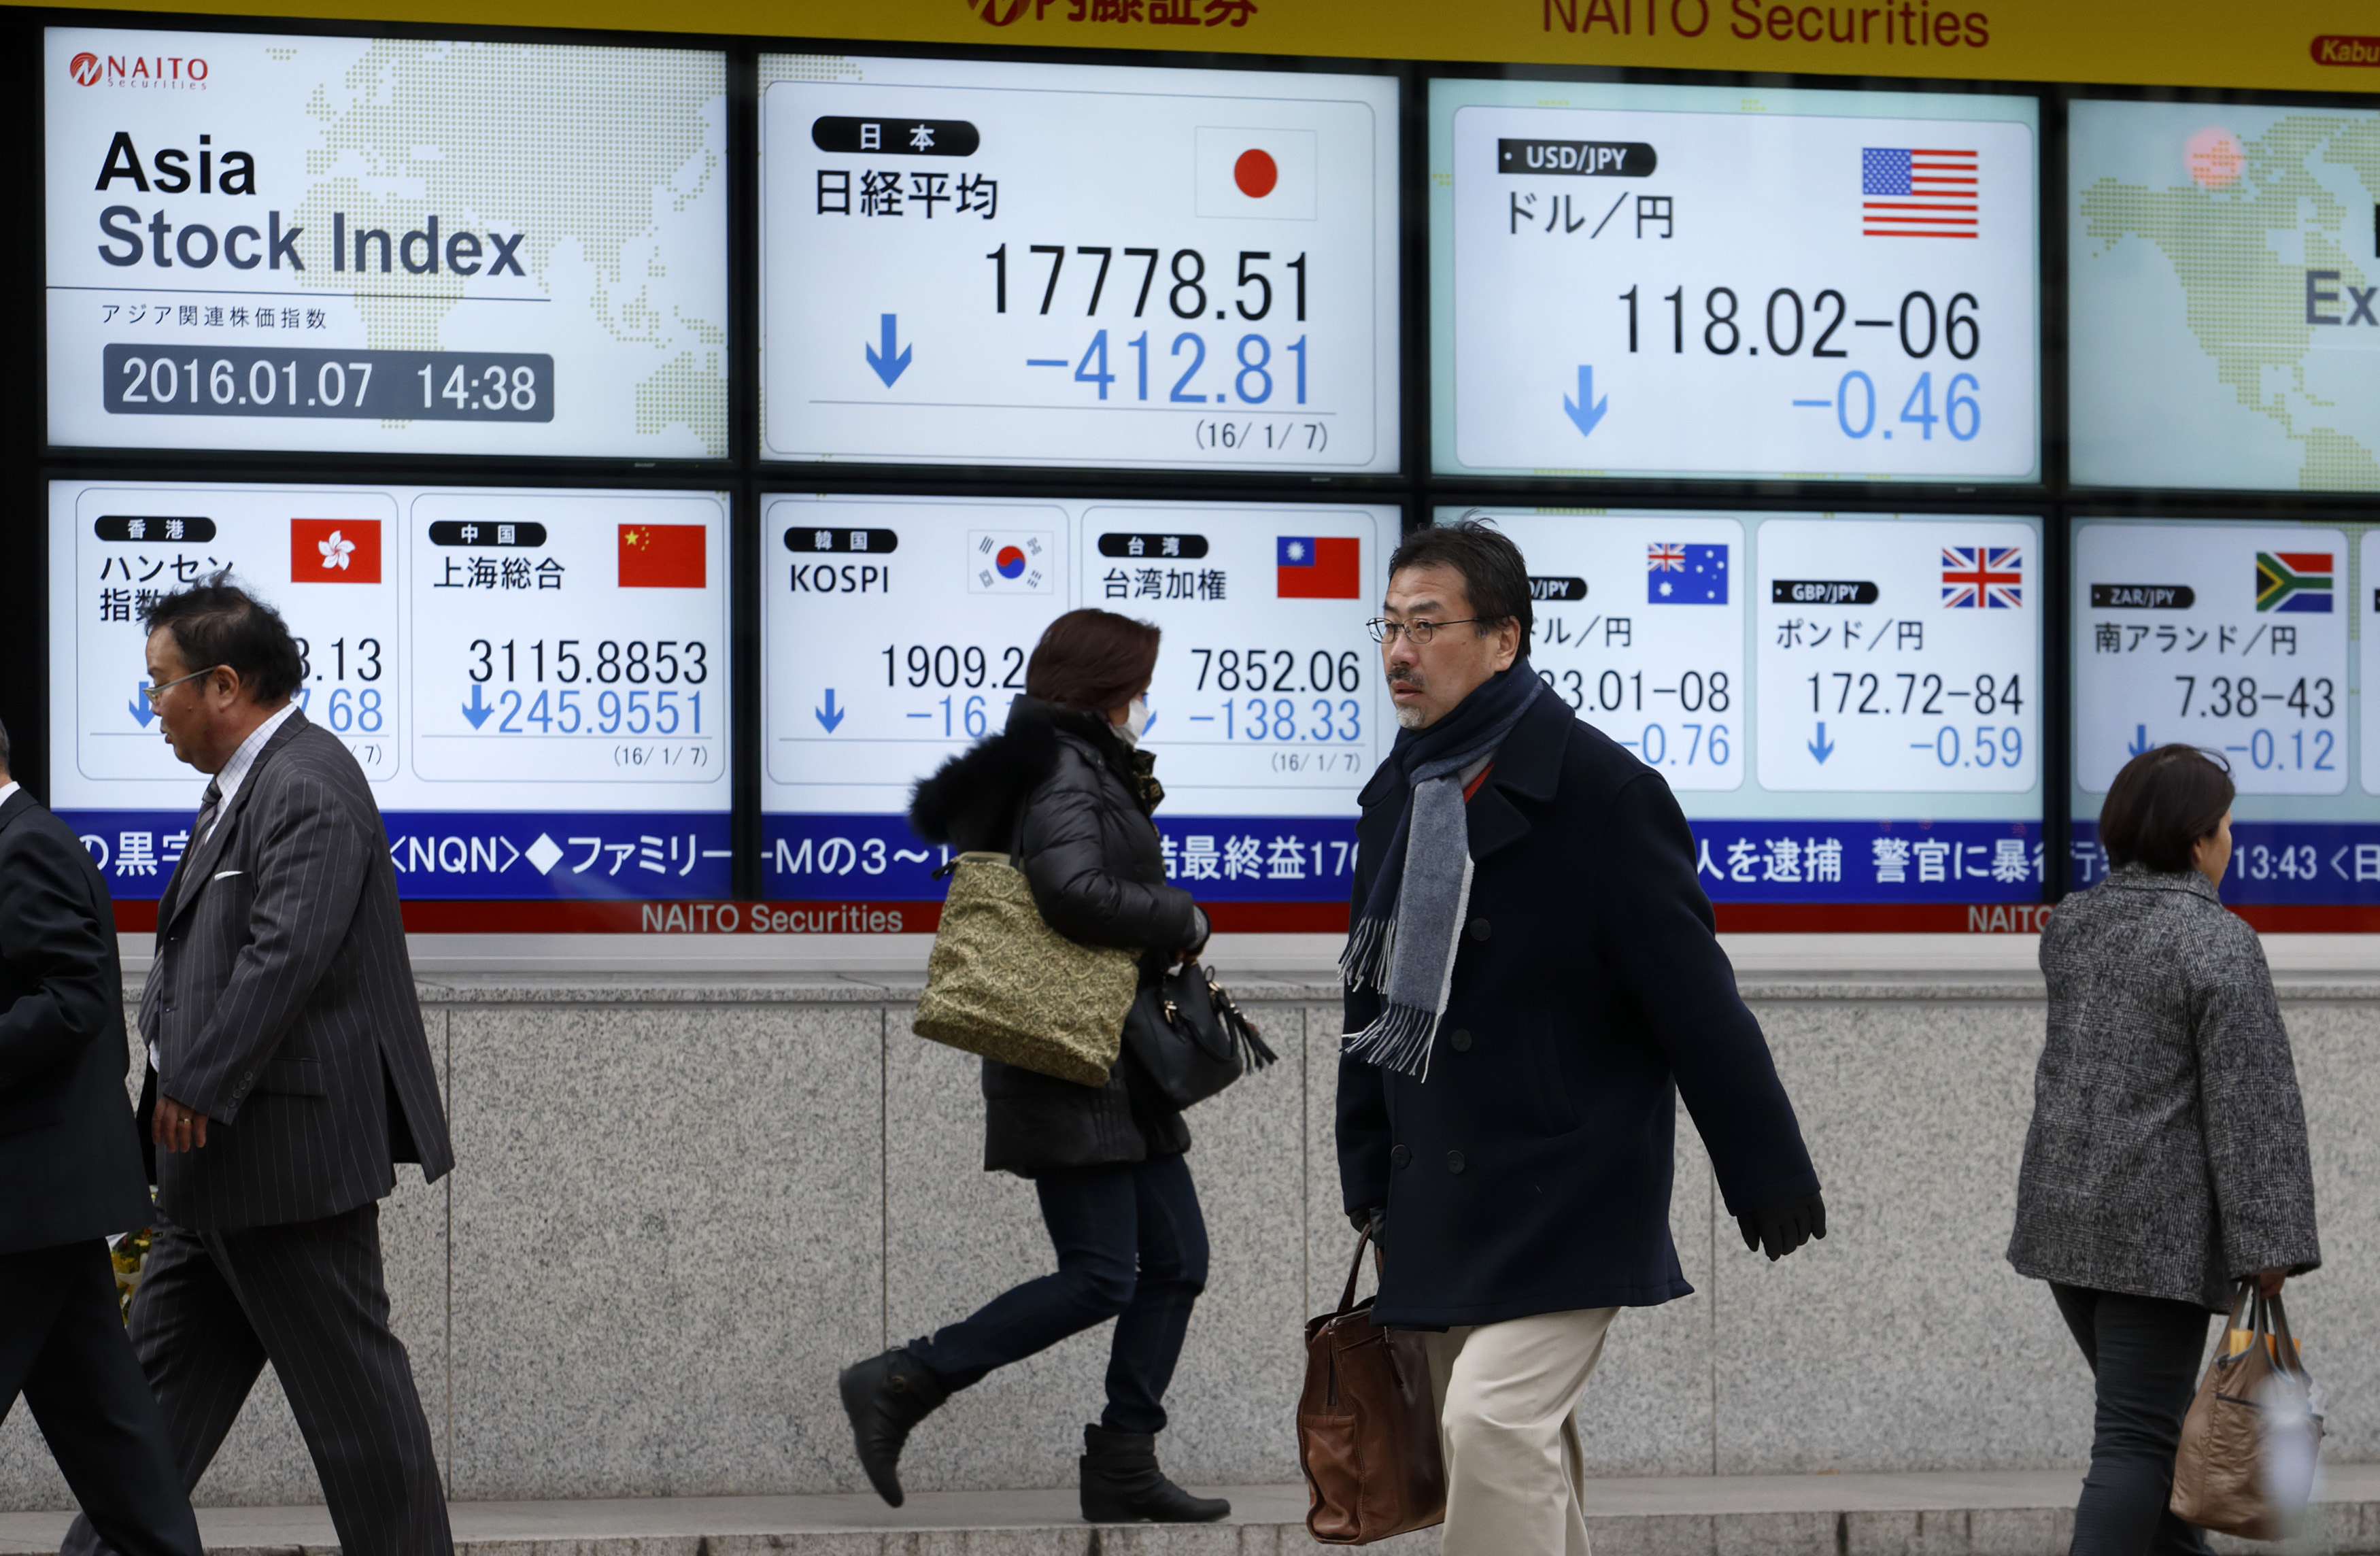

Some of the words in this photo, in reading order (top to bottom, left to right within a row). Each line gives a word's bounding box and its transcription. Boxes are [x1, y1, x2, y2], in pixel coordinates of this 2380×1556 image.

[1543, 0, 1709, 37] NAITO
[1731, 0, 1990, 48] Securities
[107, 56, 208, 81] NAITO
[107, 78, 207, 90] Securities
[95, 132, 256, 195] Asia
[1526, 145, 1627, 175] USD/JPY
[817, 169, 997, 219] 日経平均
[98, 205, 305, 272] Stock
[334, 212, 526, 276] Index
[987, 243, 1306, 321] 17778.51
[103, 305, 325, 328] アジア関連株価指数
[1620, 285, 1979, 360] 118.02-06
[123, 358, 372, 407] 2016.01.07
[418, 365, 536, 410] 14:38
[1027, 330, 1306, 404] -412.81
[1793, 371, 1981, 441] -0.46
[100, 554, 233, 583] ハンセン
[434, 557, 564, 590] 上海総合
[791, 564, 887, 592] KOSPI
[1104, 568, 1225, 600] 台湾加権
[1529, 579, 1569, 600] /JPY
[1791, 584, 1860, 604] GBP/JPY
[469, 639, 708, 685] 3115.8853
[1192, 649, 1359, 692] 7852.06
[500, 690, 700, 734] 245.9551
[1538, 670, 1729, 712] 3.01-08
[1809, 673, 2024, 715] 172.72-84
[2176, 676, 2334, 718] 7.38-43
[1190, 698, 1360, 741] -138.33
[1618, 724, 1729, 765] -0.76
[1911, 726, 2022, 767] -0.59
[2226, 729, 2335, 771] -0.12
[2235, 845, 2317, 879] 13:43
[641, 904, 740, 933] NAITO
[751, 904, 903, 932] Securities
